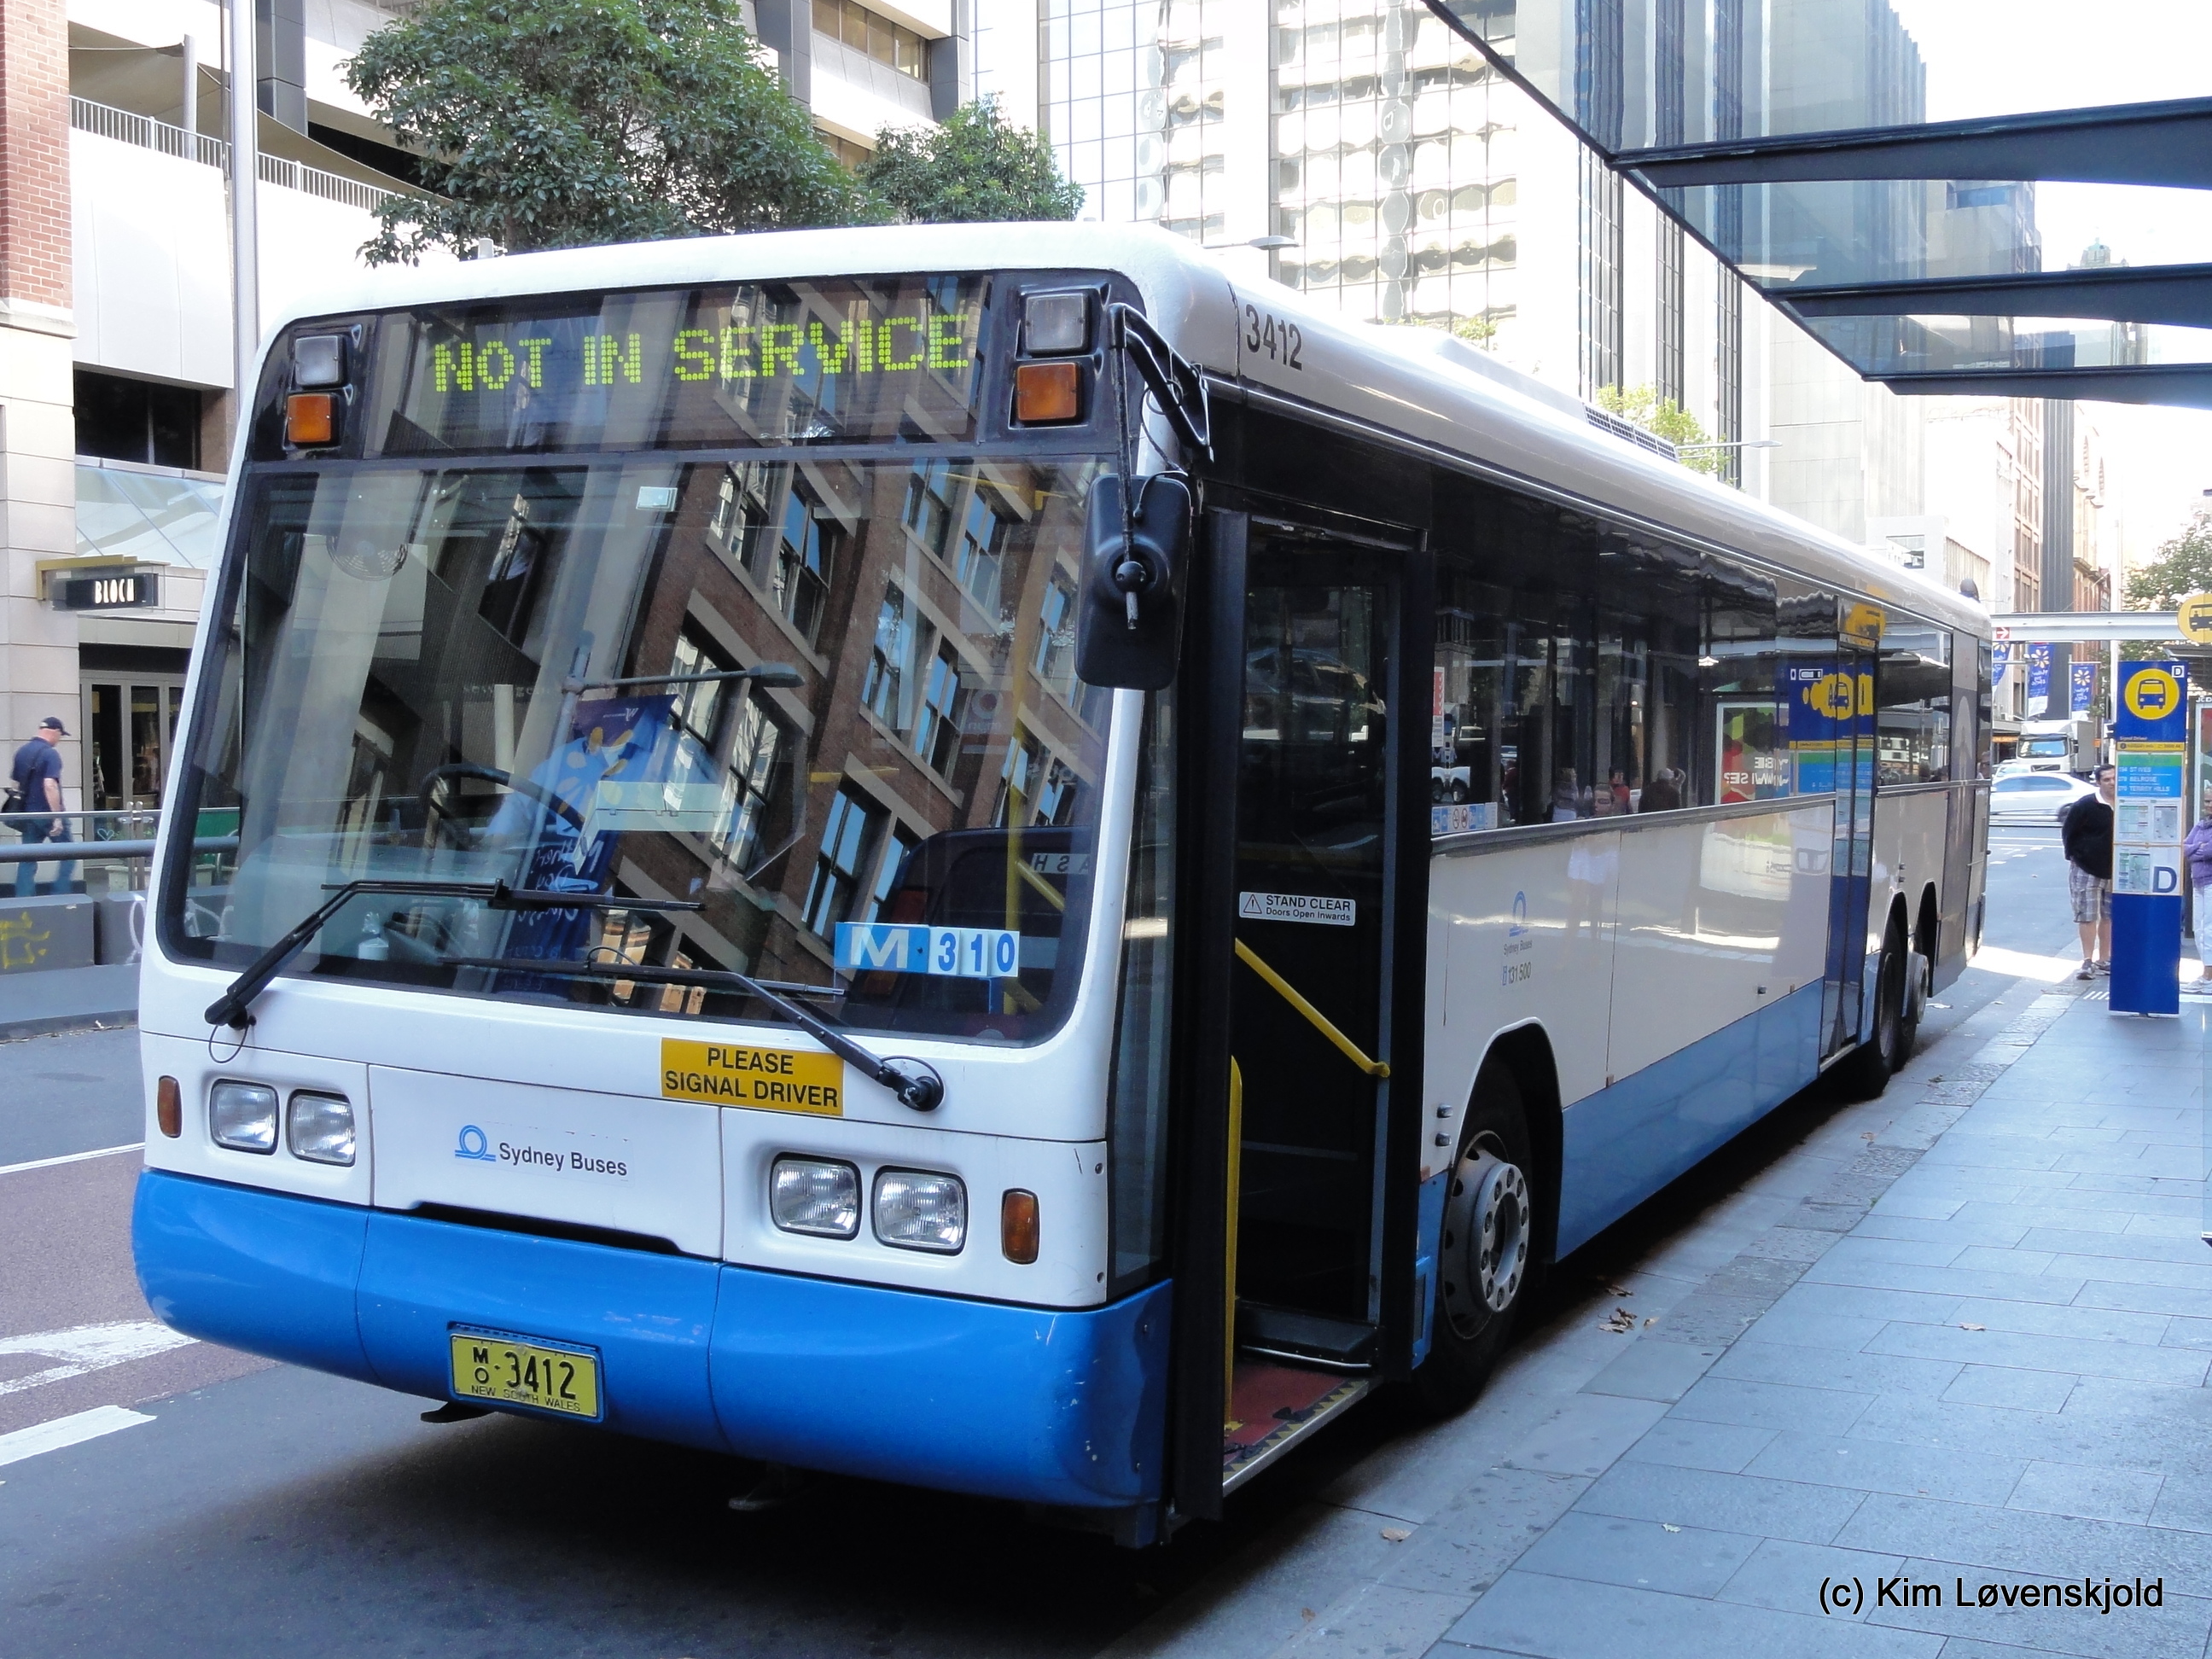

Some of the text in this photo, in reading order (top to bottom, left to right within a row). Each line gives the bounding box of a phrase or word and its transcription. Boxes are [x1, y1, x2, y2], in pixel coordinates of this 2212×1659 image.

[1245, 303, 1303, 371] 3412
[434, 314, 969, 393] NOT IN SERVICE
[2174, 667, 2183, 676] D
[2152, 866, 2177, 894] D
[1266, 894, 1351, 911] STAND CLEAR
[1266, 907, 1351, 922] Doors Open Inwards
[850, 926, 1016, 973] M 310
[707, 1046, 795, 1075] PLEASE
[665, 1070, 839, 1109] SIGNAL DRIVER
[498, 1141, 628, 1177] Sydney Buses
[504, 1350, 577, 1400] 3412
[471, 1384, 497, 1397] NEW
[544, 1395, 581, 1412] WALES
